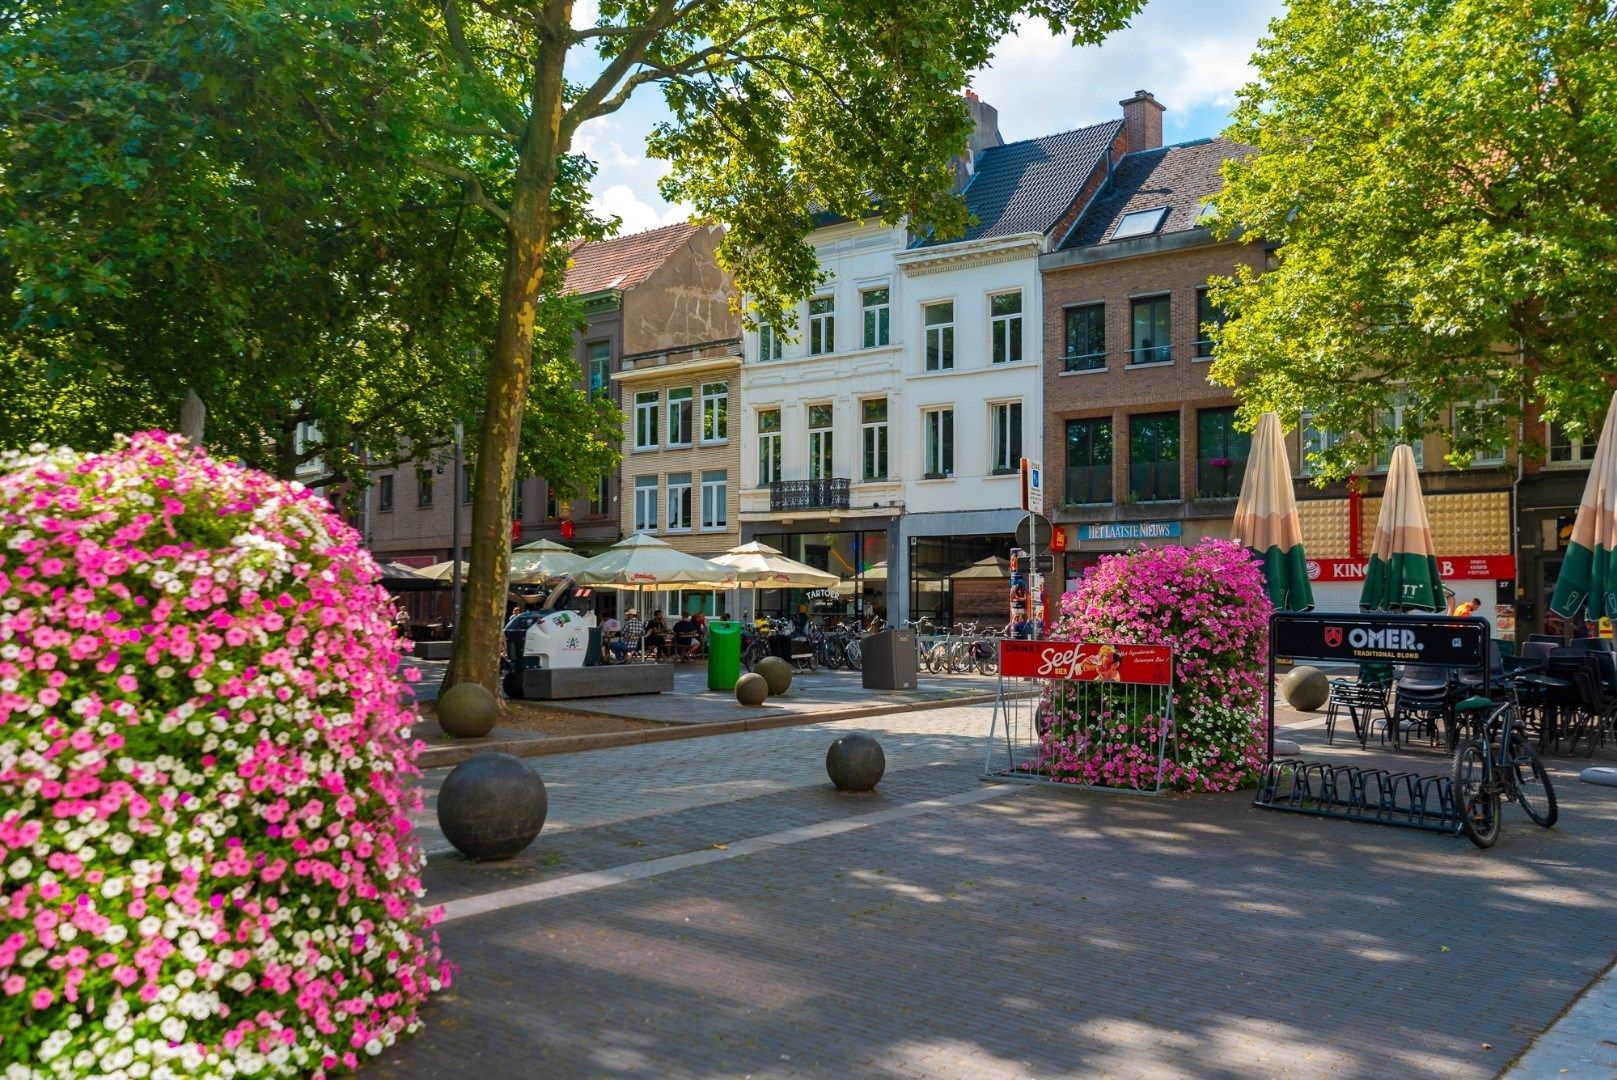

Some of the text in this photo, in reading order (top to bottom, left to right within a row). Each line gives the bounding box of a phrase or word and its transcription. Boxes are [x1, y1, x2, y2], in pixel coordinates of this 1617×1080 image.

[1088, 522, 1170, 538] HET LAATSTE NIEUWS
[1348, 627, 1425, 651] OMER.
[1037, 643, 1086, 680] Seef
[1353, 649, 1395, 658] TRADITIONAL
[1054, 667, 1068, 675] BIER
